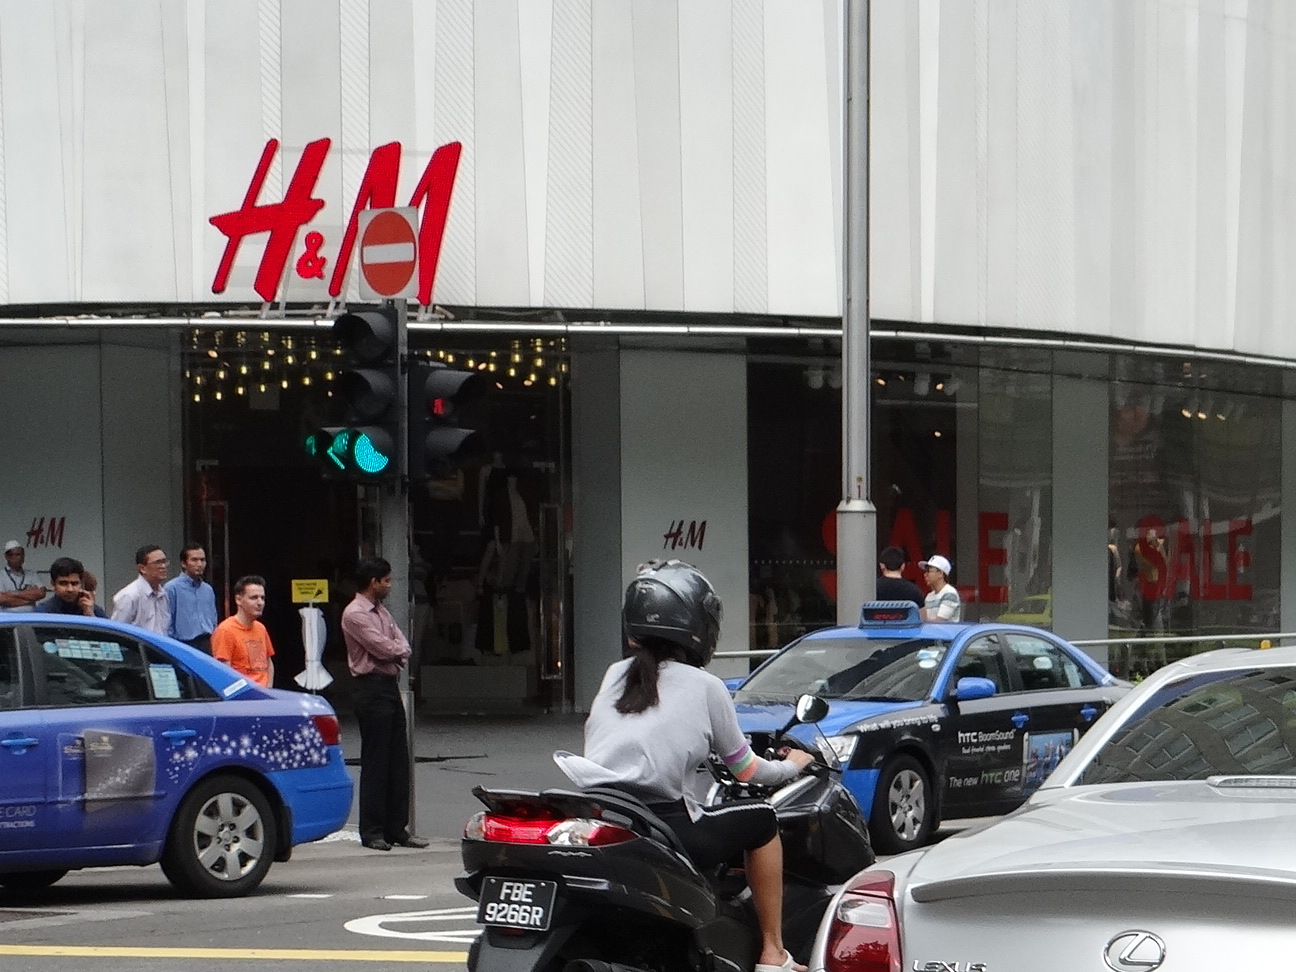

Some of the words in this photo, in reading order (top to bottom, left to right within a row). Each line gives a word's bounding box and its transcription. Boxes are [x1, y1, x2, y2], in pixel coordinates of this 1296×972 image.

[209, 138, 462, 306] H&M
[26, 516, 65, 550] H&M
[663, 519, 707, 551] H&M
[1137, 514, 1252, 601] SALE
[949, 776, 962, 788] The
[963, 777, 978, 787] new
[499, 881, 536, 903] FBE
[484, 902, 544, 926] 9266R
